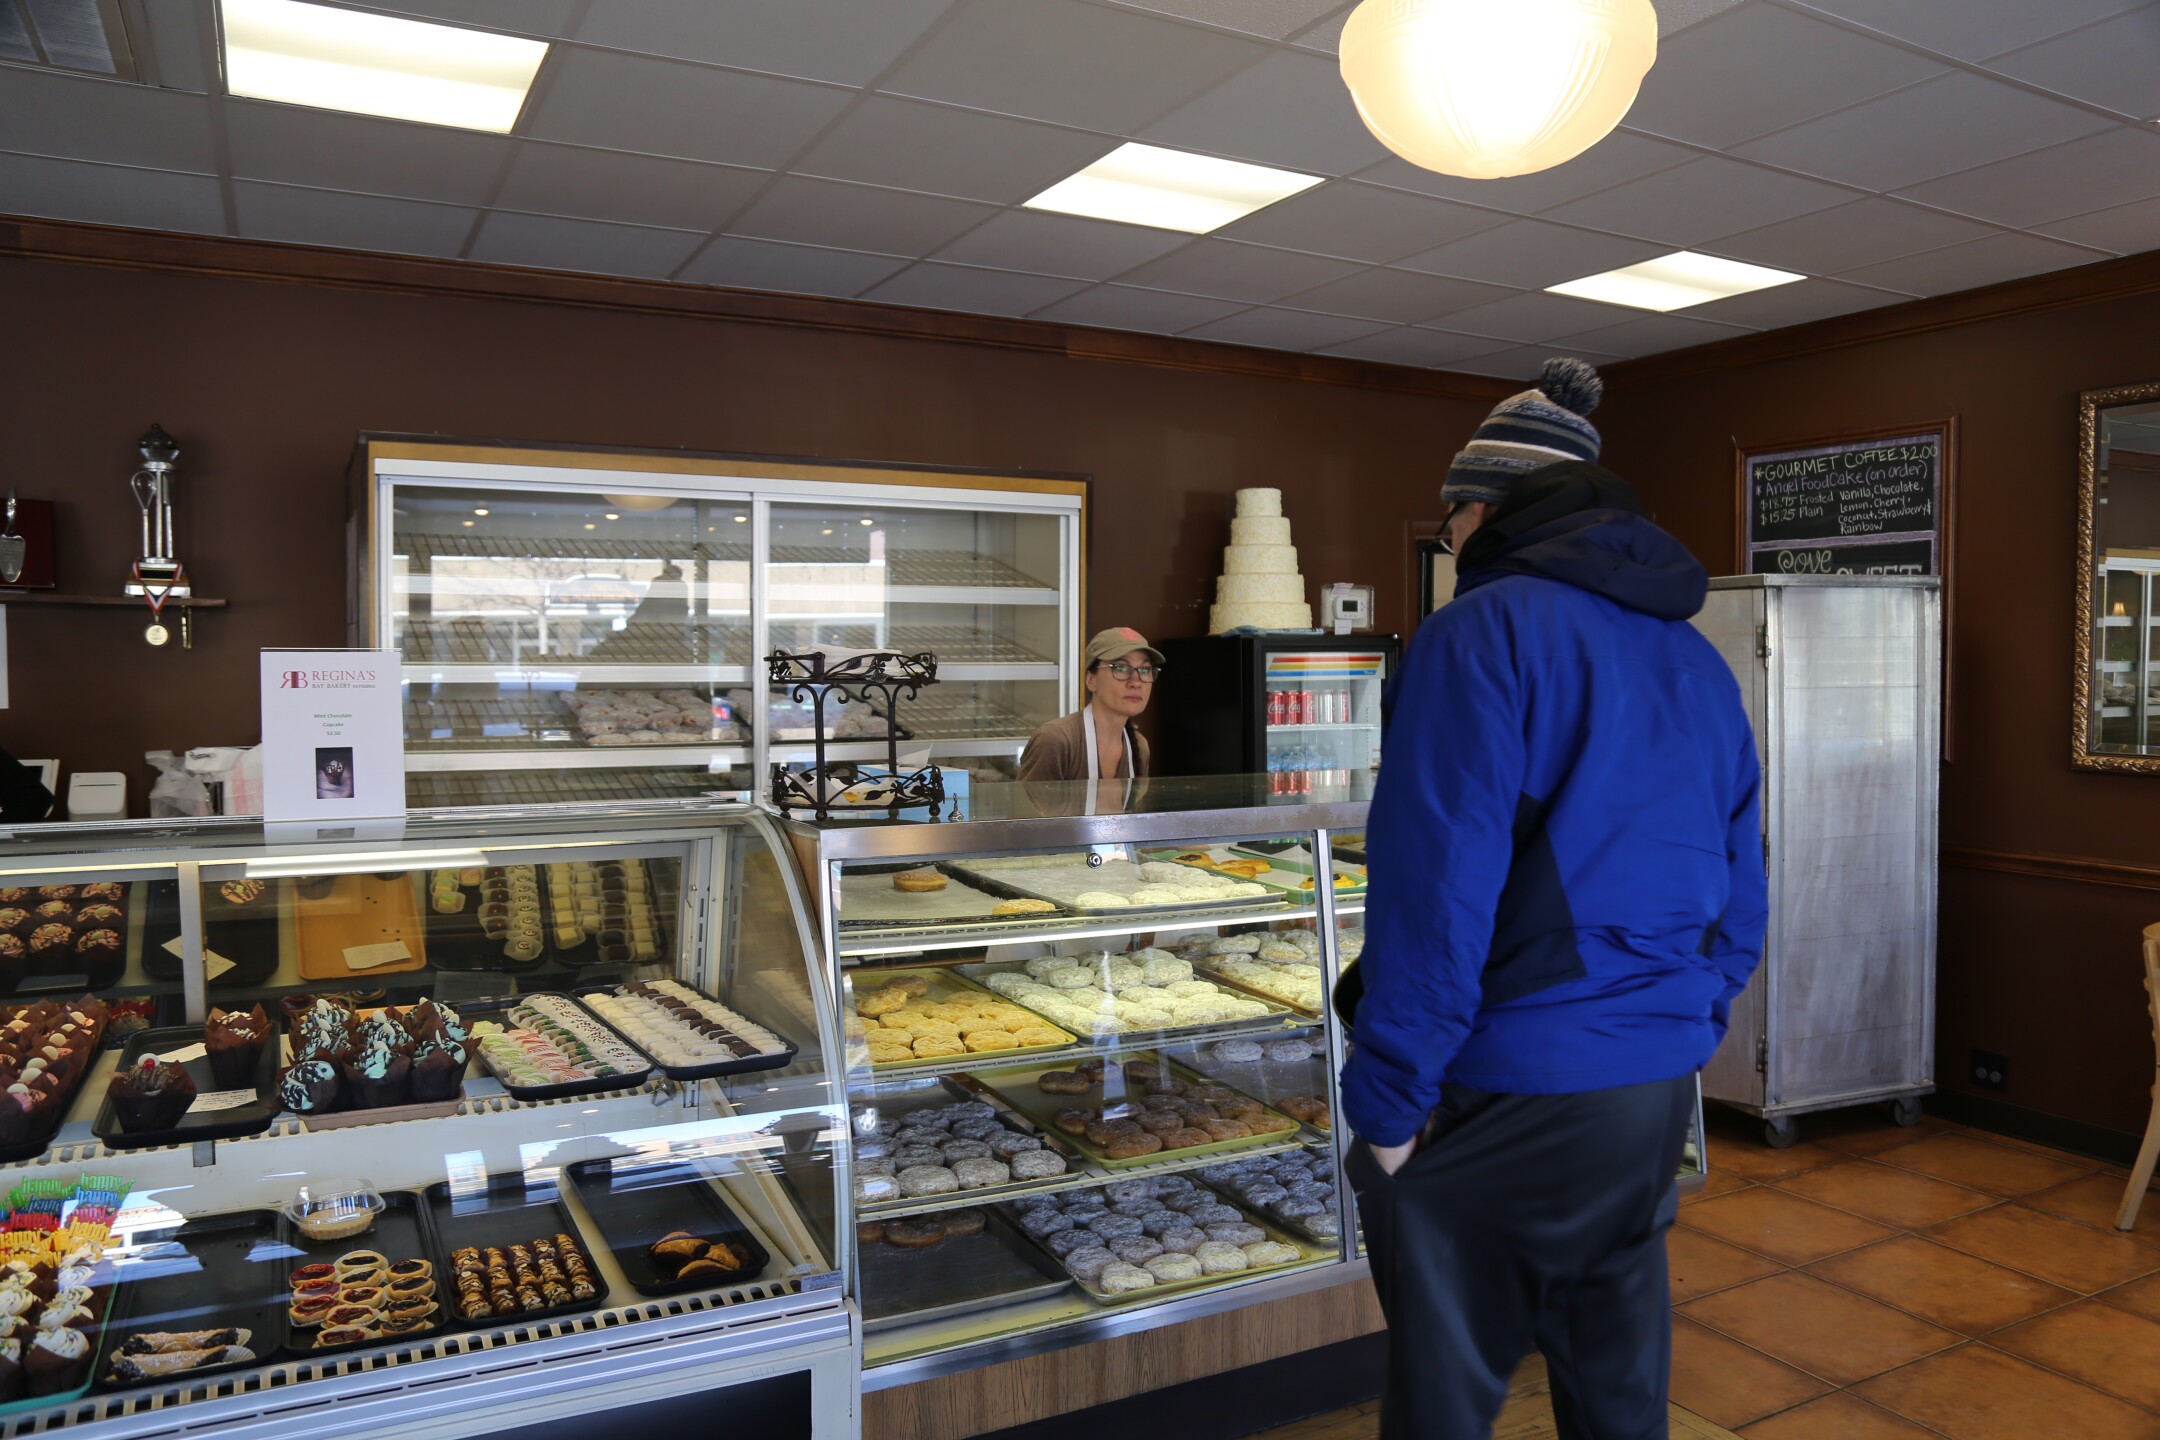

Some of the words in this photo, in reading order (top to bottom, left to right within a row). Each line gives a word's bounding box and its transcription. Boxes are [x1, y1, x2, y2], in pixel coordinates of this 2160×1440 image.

[1765, 455, 1840, 481] GOURMET
[1844, 447, 1898, 469] COFFEE
[1900, 444, 1938, 461] $2.00
[1766, 478, 1798, 496] Angel
[1865, 466, 1886, 485] (on
[1888, 460, 1928, 479] order)
[1799, 491, 1834, 506] Frosted
[1799, 505, 1824, 519] Plain
[1840, 521, 1883, 535] Rainbow
[312, 671, 376, 681] REGINA'S
